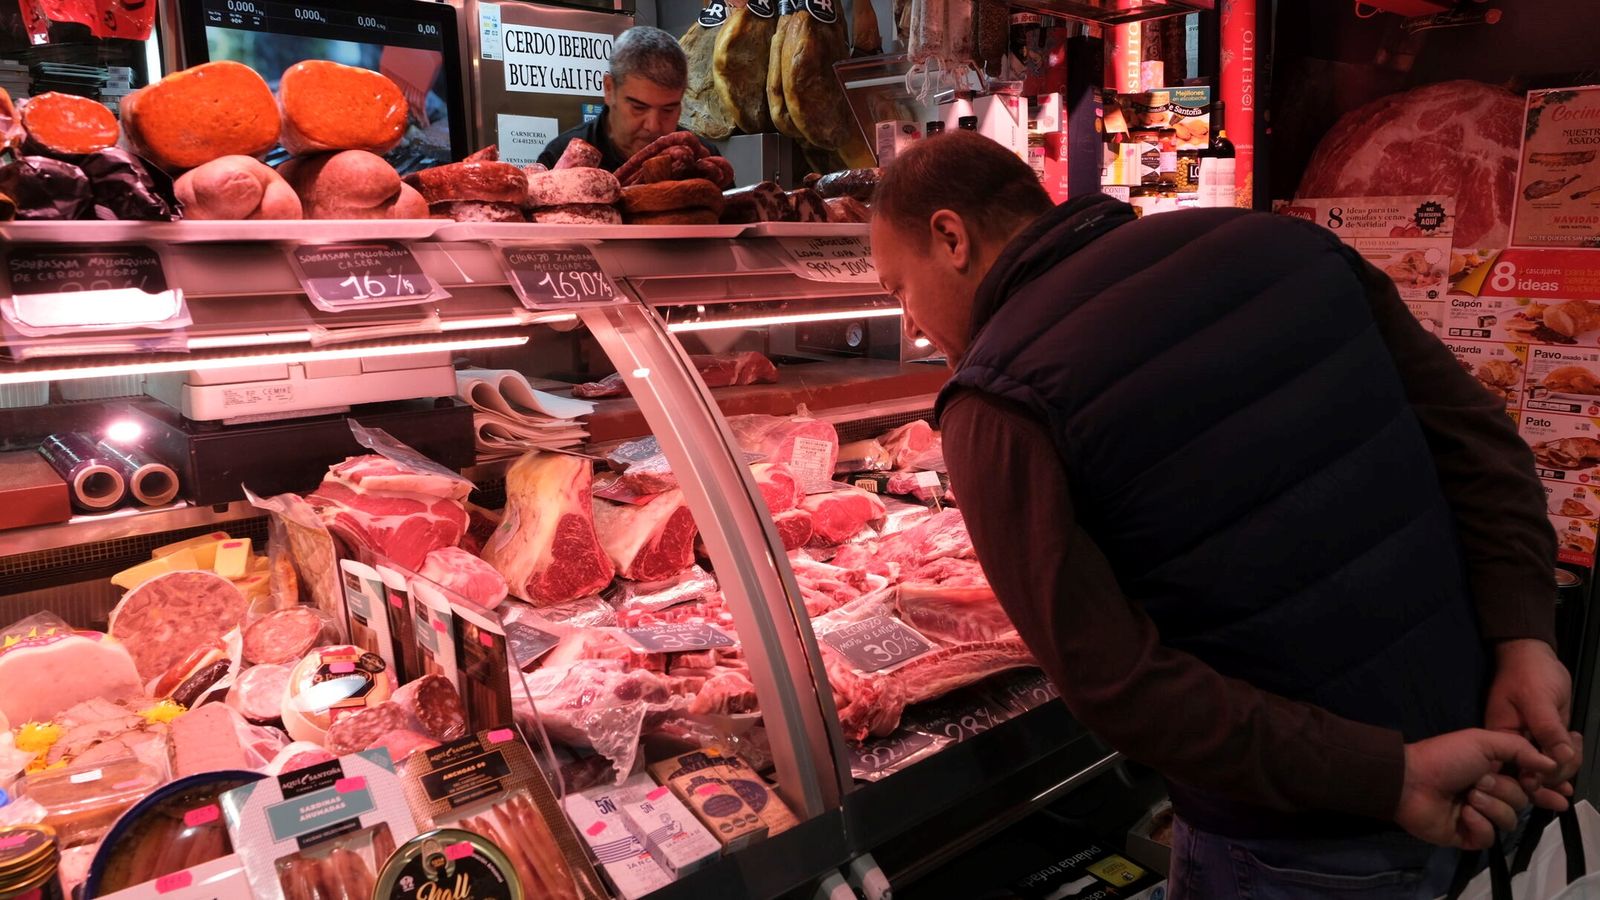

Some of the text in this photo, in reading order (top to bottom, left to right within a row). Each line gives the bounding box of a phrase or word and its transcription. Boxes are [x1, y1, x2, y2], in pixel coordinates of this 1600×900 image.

[295, 8, 320, 21] 0,000
[358, 16, 376, 27] 0,00
[418, 23, 436, 34] 0,00
[505, 29, 555, 56] CERDO
[558, 34, 613, 61] IBERICO
[509, 63, 548, 88] BUEY
[1242, 30, 1253, 112] JOSELITO
[1175, 90, 1204, 98] Mejillones
[1174, 104, 1203, 116] Santoña
[510, 130, 547, 139] CARNICERIA
[1563, 128, 1600, 137] NUESTR
[1567, 137, 1600, 145] ASADO
[1327, 207, 1343, 229] 8
[1367, 207, 1386, 216] para
[1346, 213, 1378, 221] comidas
[1420, 216, 1437, 225] AQUÍ
[1553, 215, 1600, 225] NAVIDAD
[1491, 261, 1517, 292] 8
[1517, 278, 1559, 292] ideas
[1451, 299, 1482, 308] Capón
[1534, 349, 1562, 359] Pavo
[1526, 416, 1551, 427] Pato
[300, 796, 342, 814] SARDINAS
[299, 802, 346, 821] AHUMADAS
[1058, 843, 1102, 868] pularda
